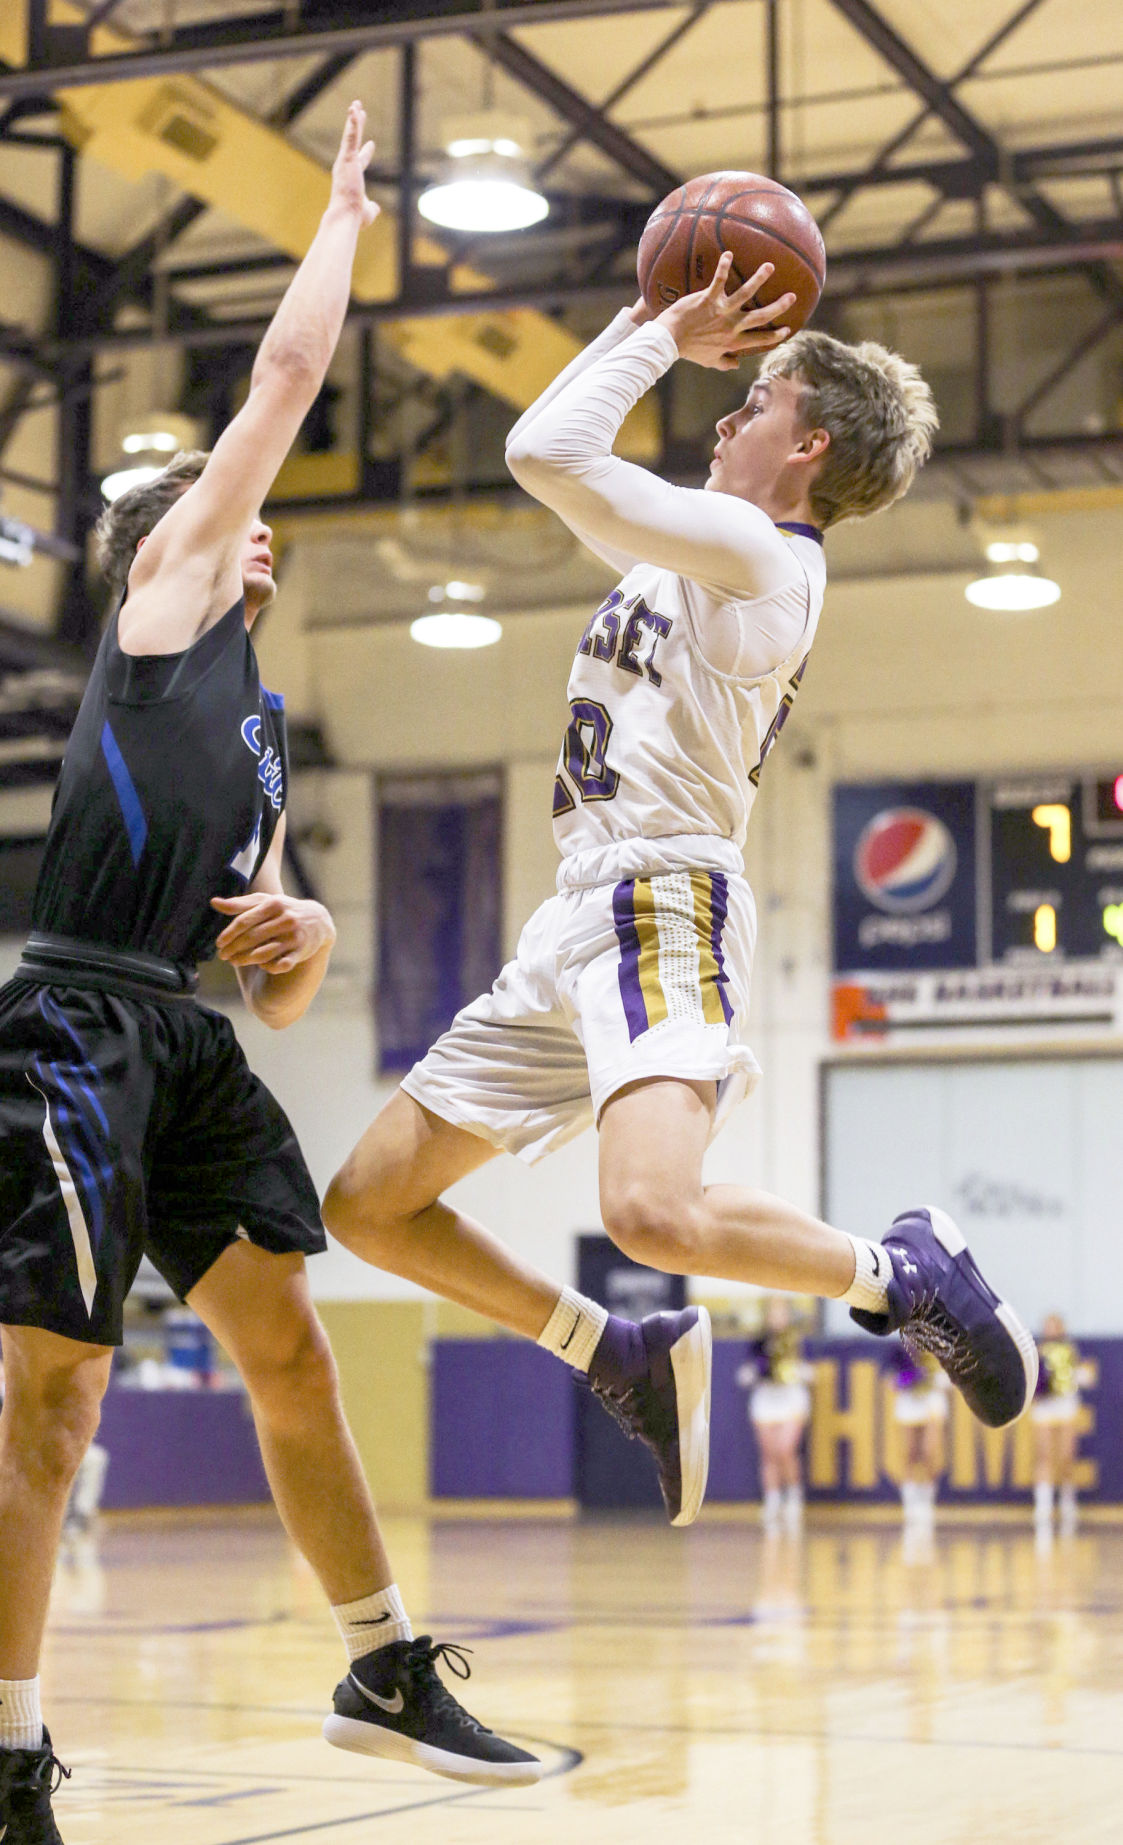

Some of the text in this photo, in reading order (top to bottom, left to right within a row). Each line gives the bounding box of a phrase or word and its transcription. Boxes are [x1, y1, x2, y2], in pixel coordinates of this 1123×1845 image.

[552, 697, 621, 818] 0
[1032, 804, 1071, 863] 7
[1035, 904, 1056, 952] 1
